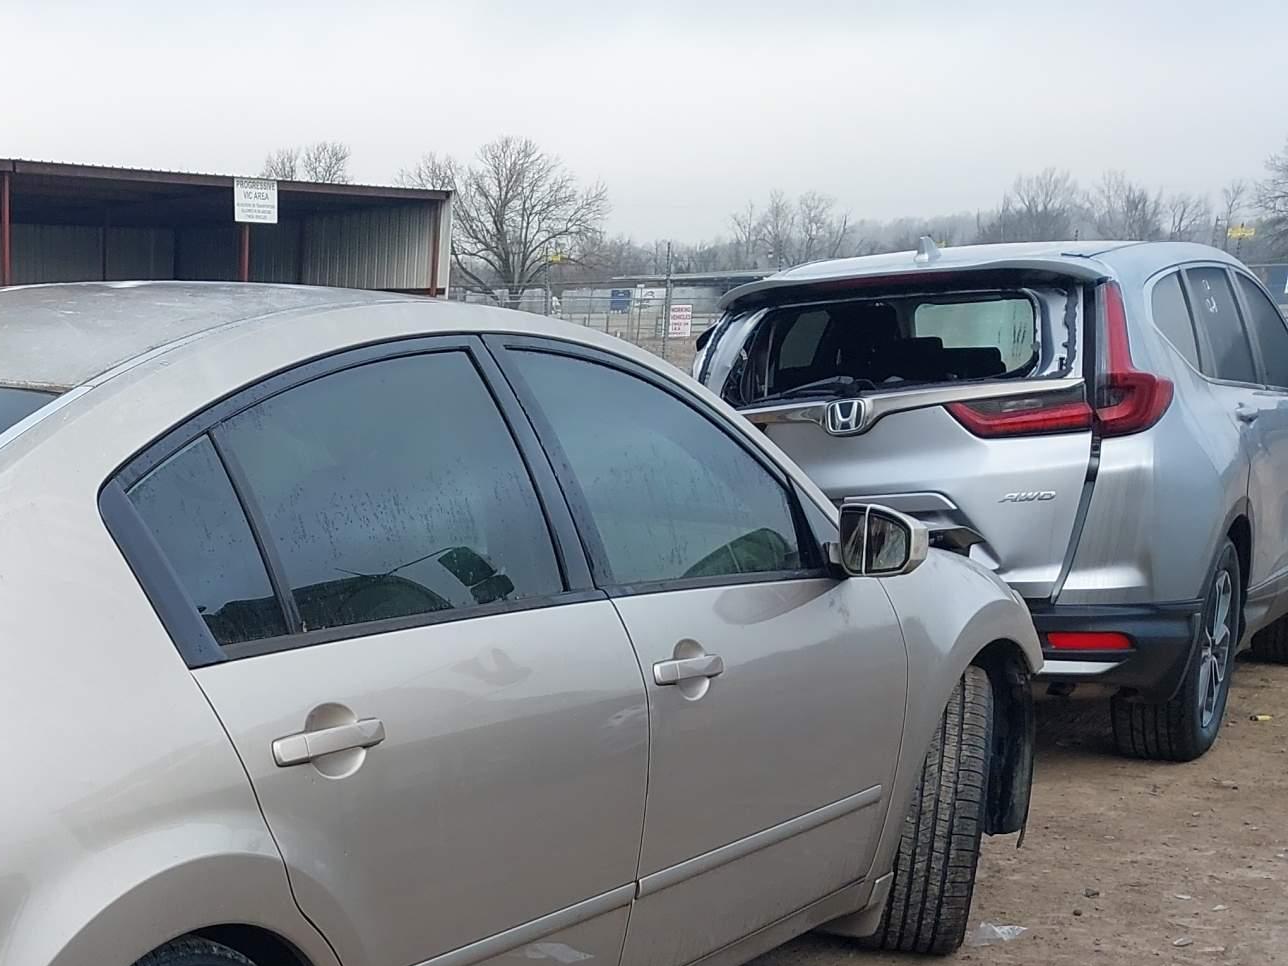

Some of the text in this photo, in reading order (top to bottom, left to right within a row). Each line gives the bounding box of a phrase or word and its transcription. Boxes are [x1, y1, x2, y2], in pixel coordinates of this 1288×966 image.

[236, 180, 276, 191] PROGRESSIVE
[243, 191, 270, 200] VIC AREA
[997, 491, 1056, 503] AWD
